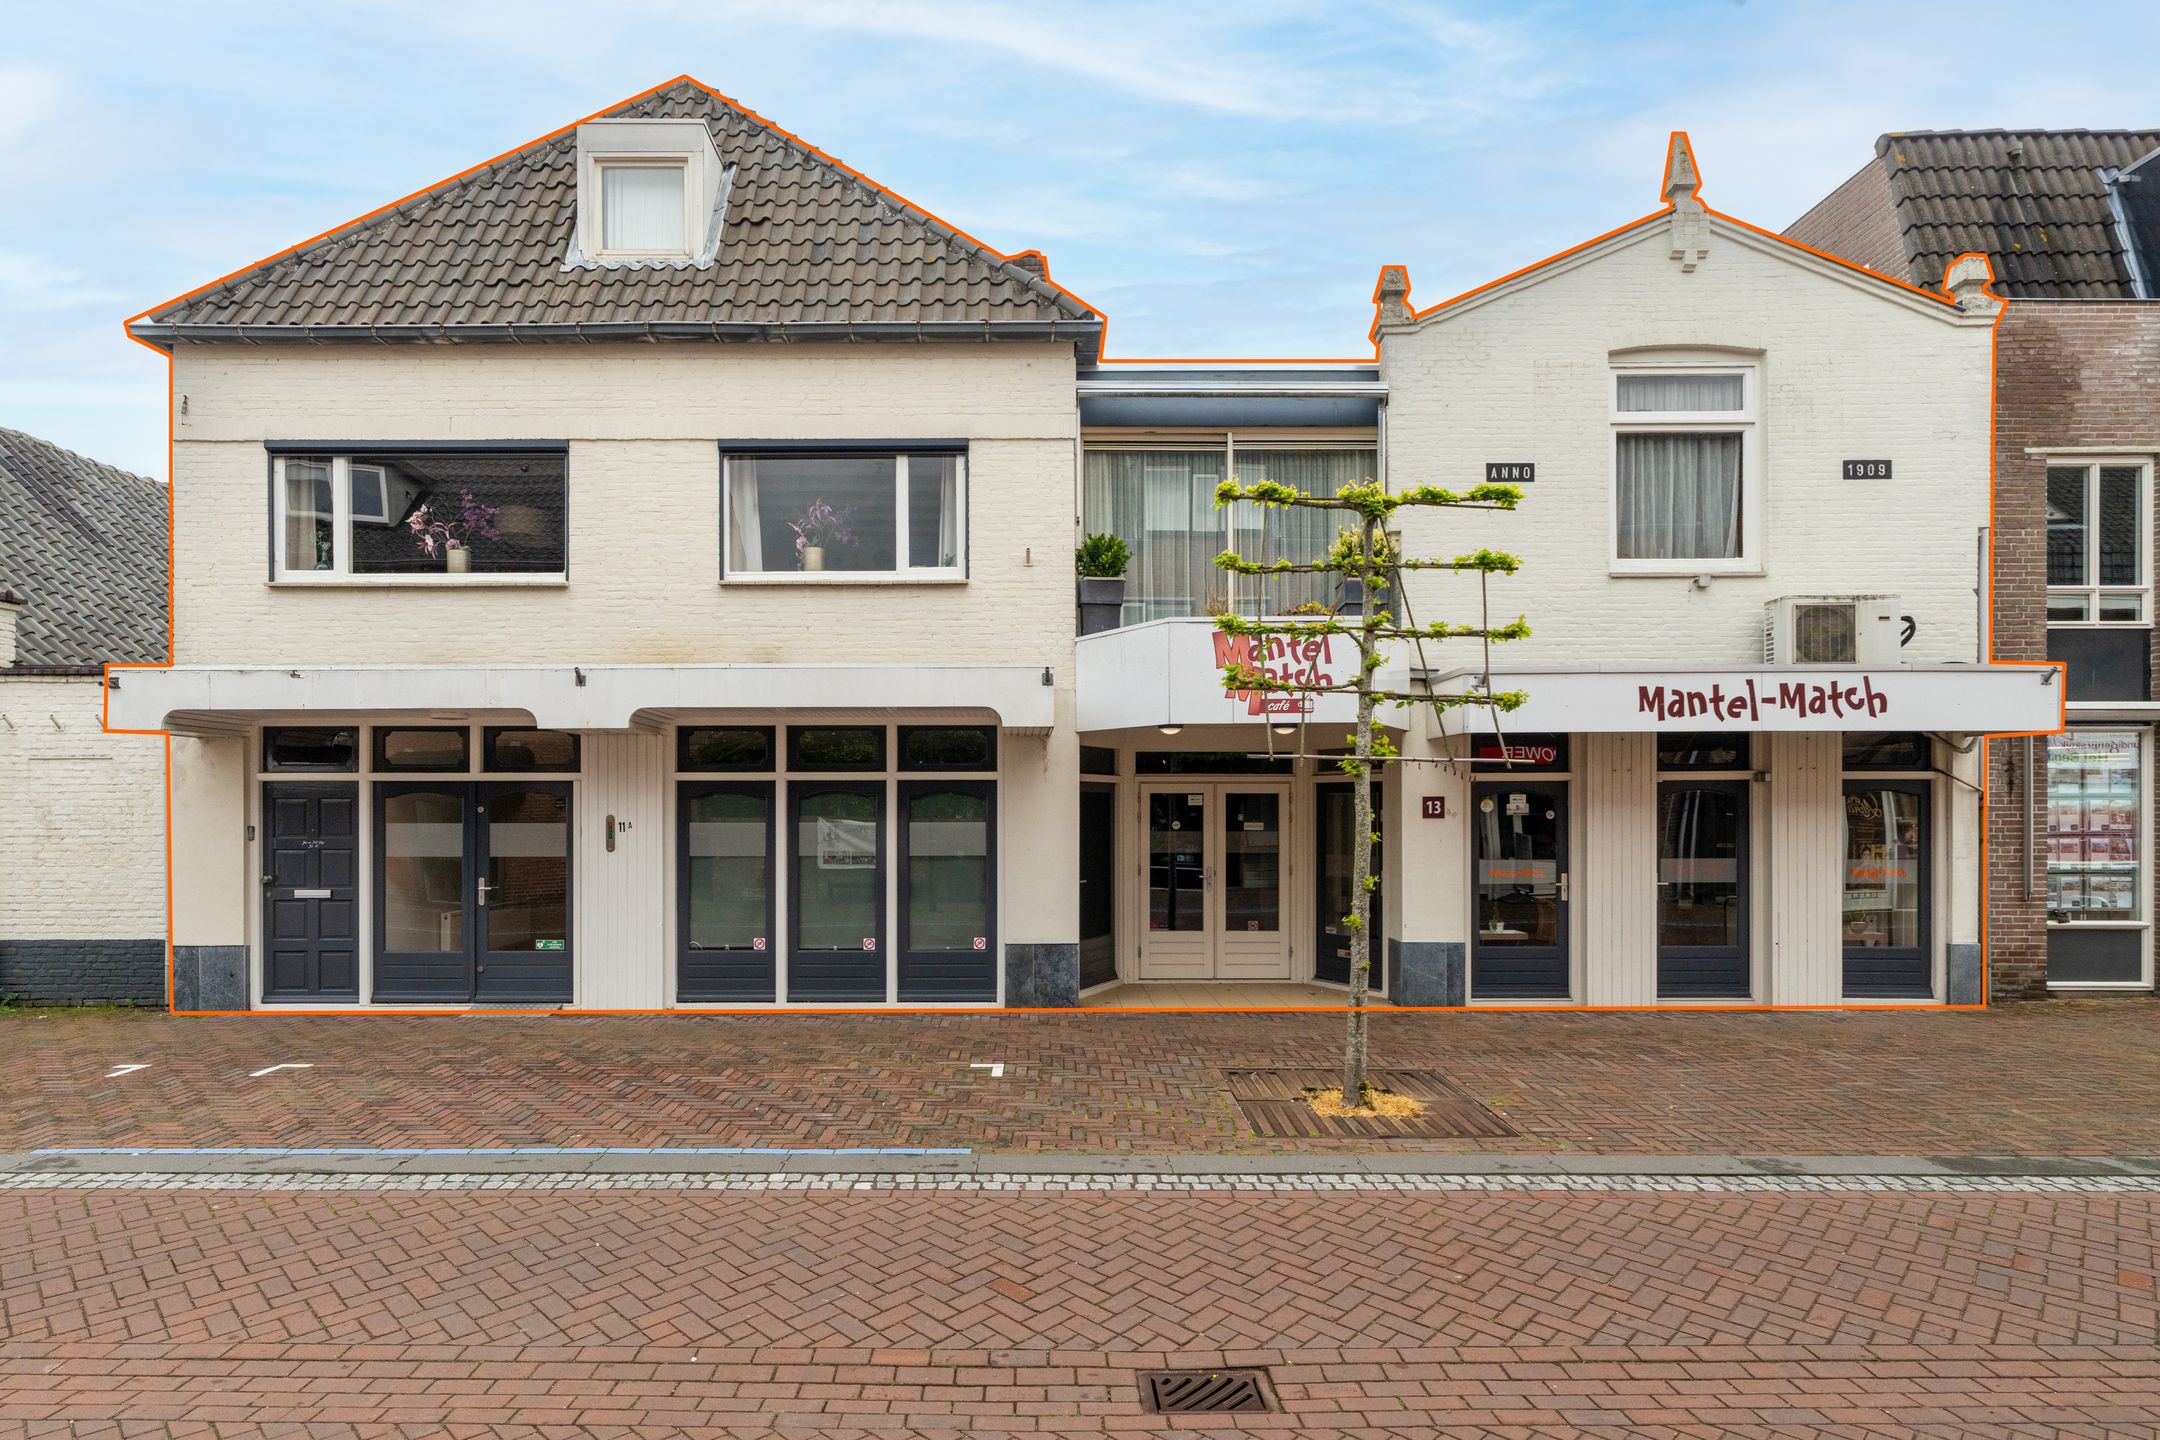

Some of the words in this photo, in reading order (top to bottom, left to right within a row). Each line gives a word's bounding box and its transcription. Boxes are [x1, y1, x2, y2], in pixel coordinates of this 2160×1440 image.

[1490, 466, 1531, 479] ANNO
[1847, 463, 1886, 477] 1909
[1211, 631, 1333, 673] Mantel
[1267, 699, 1291, 712] café
[1638, 675, 1888, 722] Mantel-Match
[1426, 800, 1441, 814] 13
[618, 821, 626, 833] 11
[627, 821, 633, 829] A
